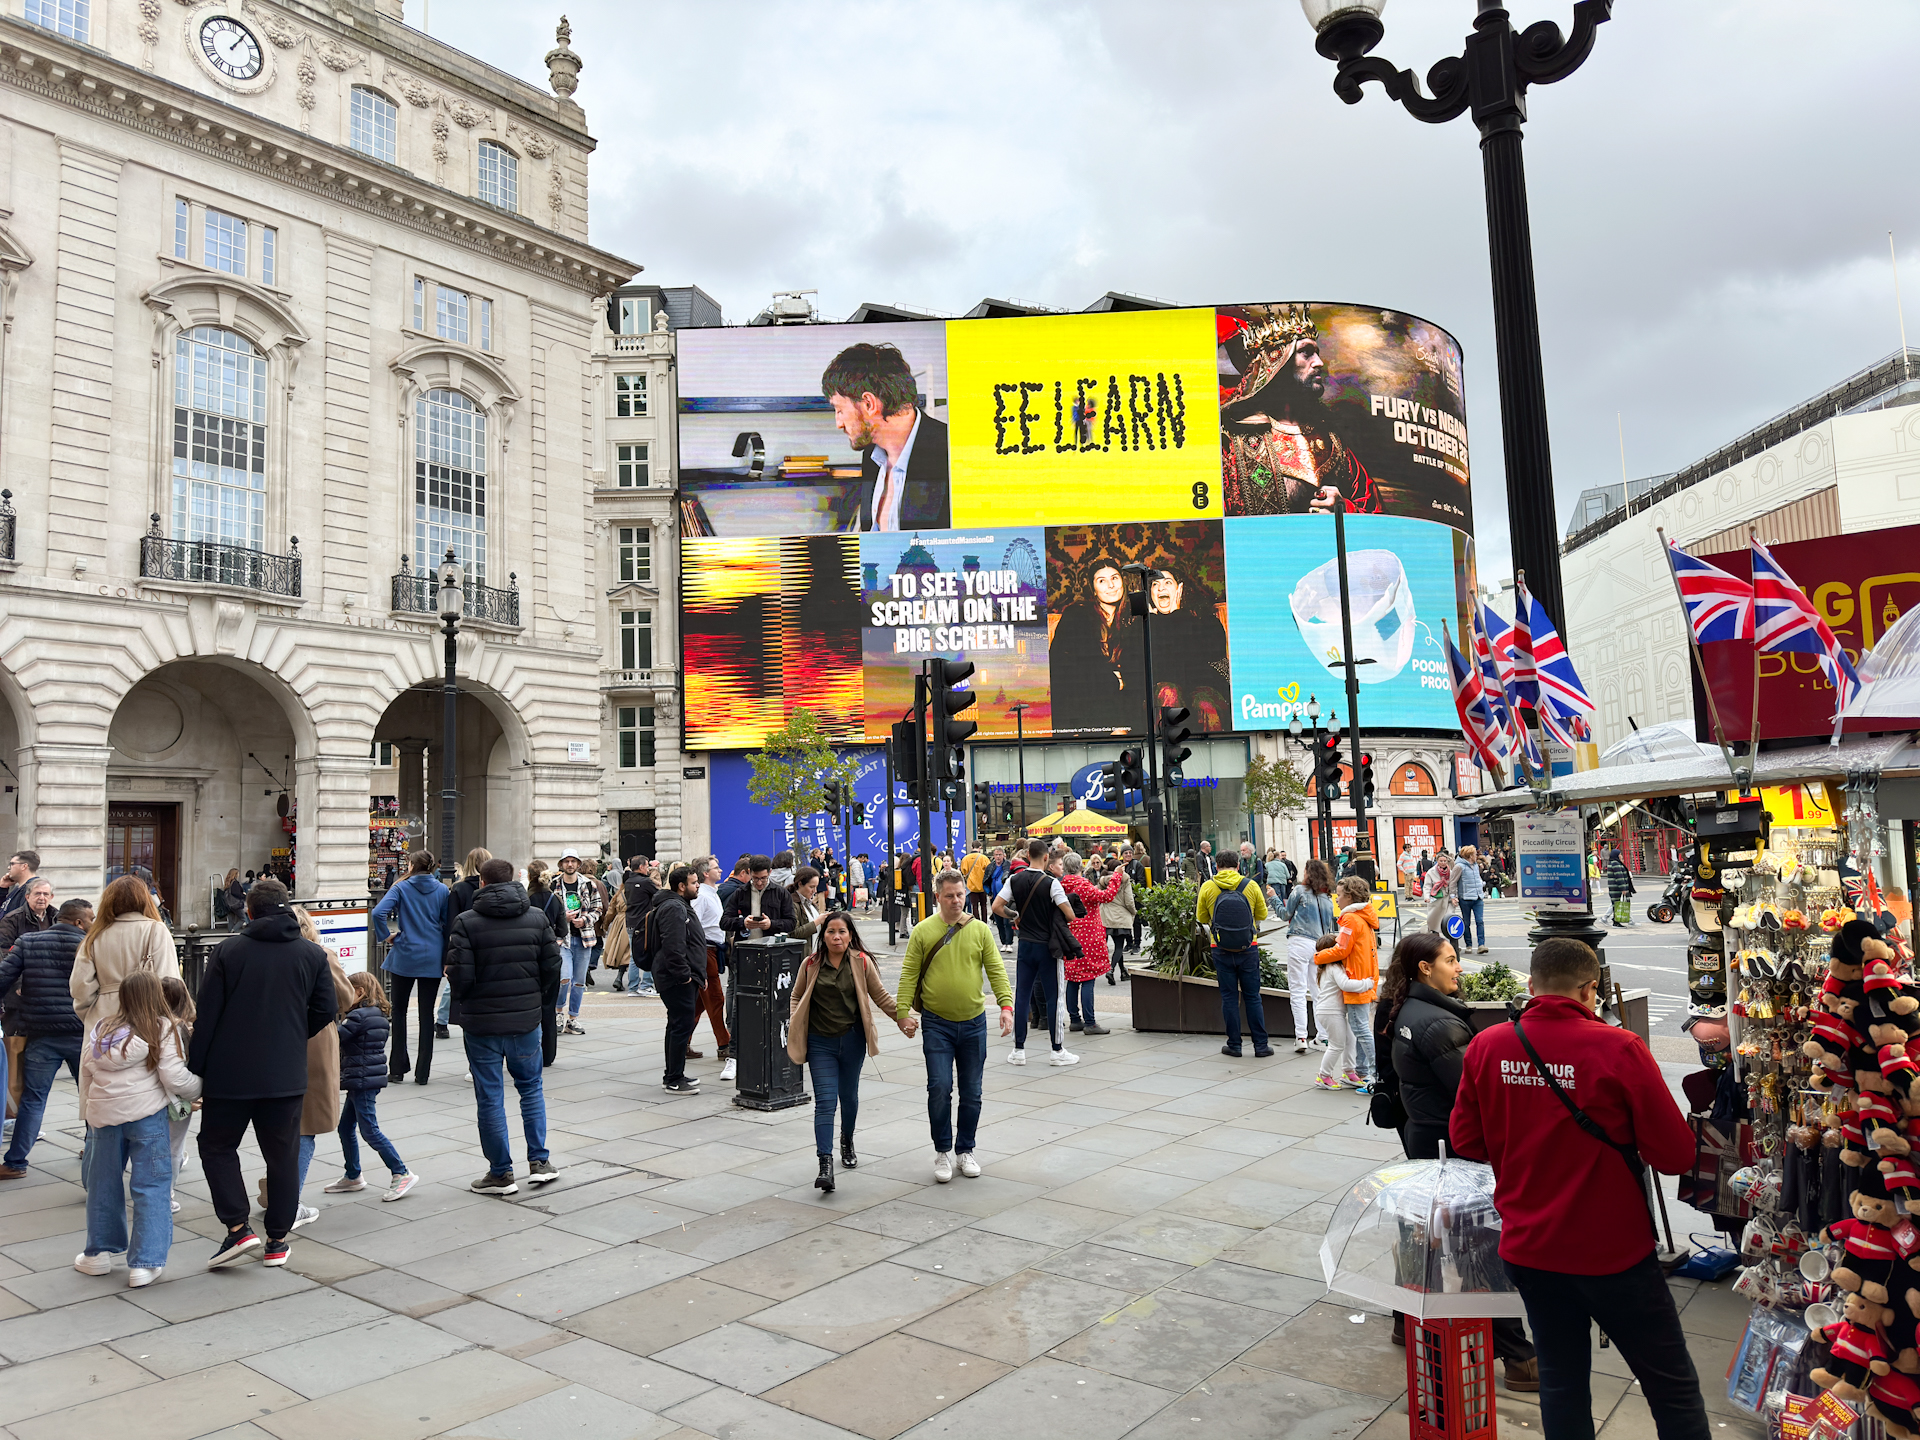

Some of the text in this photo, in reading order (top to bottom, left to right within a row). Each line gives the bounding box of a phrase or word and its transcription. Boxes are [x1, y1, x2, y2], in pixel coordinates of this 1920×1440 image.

[1370, 395, 1420, 422] FURY
[1422, 406, 1437, 426] VS
[1394, 421, 1459, 460] OCTOBER
[1413, 454, 1436, 467] BATTLE
[1437, 458, 1444, 469] OF
[1444, 462, 1454, 474] THE
[910, 536, 994, 546] #FantaHauntedMansionGB
[888, 570, 1018, 598] TO SEE YOUR
[871, 596, 1038, 626] SCREAM ON THE
[896, 624, 1014, 653] BIG SCREEN
[1421, 675, 1452, 690] PROO
[1174, 775, 1220, 789] eauty
[1408, 825, 1429, 836] ENTER
[1404, 836, 1435, 846] THE FANTA
[1500, 1060, 1530, 1075] BUY
[1501, 1074, 1545, 1086] TICKETS
[1832, 1402, 1853, 1422] TICKETS
